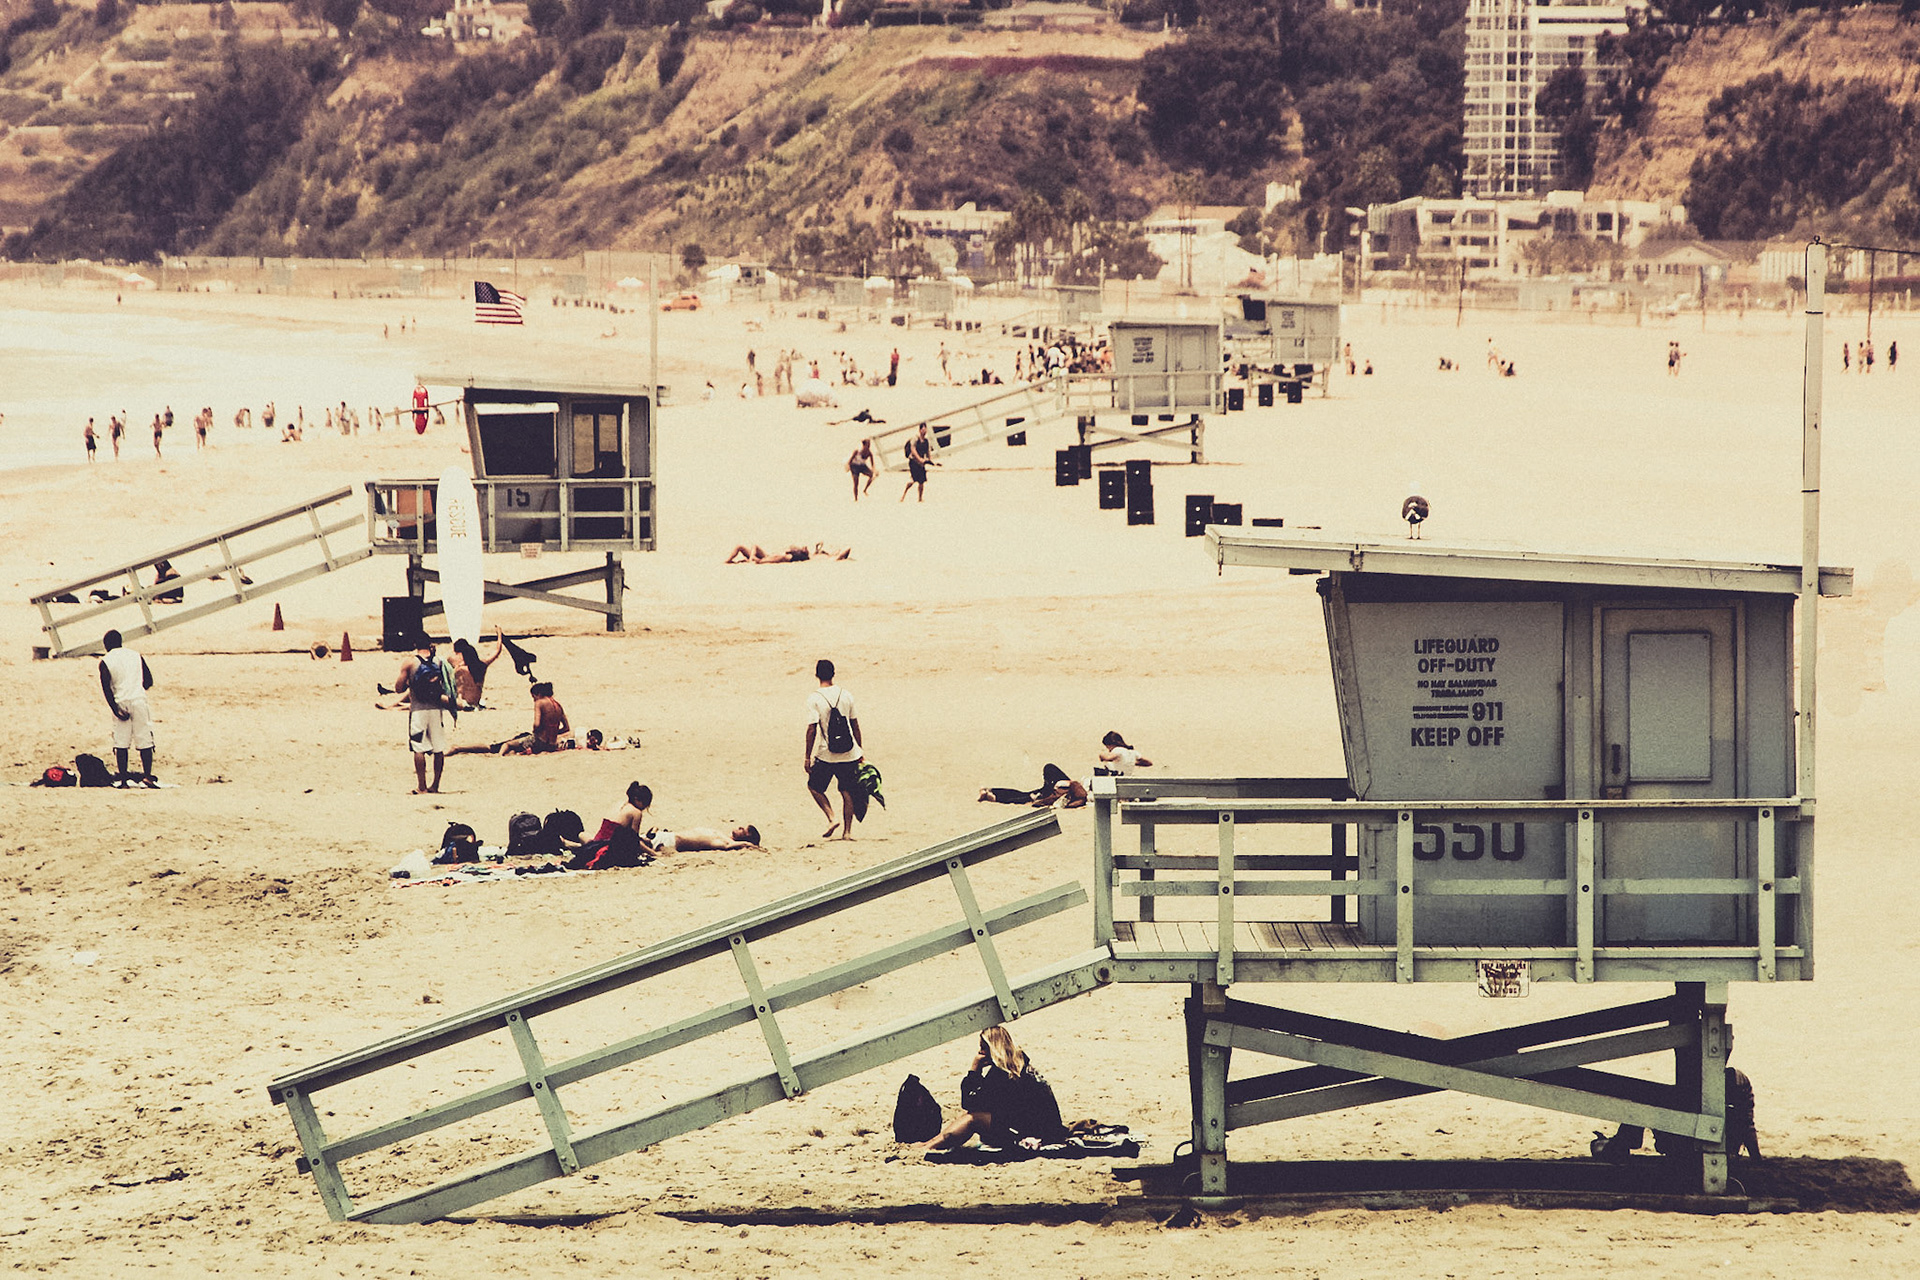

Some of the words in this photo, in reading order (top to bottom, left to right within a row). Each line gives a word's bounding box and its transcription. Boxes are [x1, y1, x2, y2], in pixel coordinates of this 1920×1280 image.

[507, 488, 531, 508] 15
[1414, 637, 1500, 654] LIFEGUARD
[1417, 657, 1496, 673] OFF-DUTY
[1417, 680, 1429, 688] NO
[1471, 701, 1503, 721] 911
[1411, 726, 1461, 747] KEEP
[1467, 726, 1505, 747] OFF
